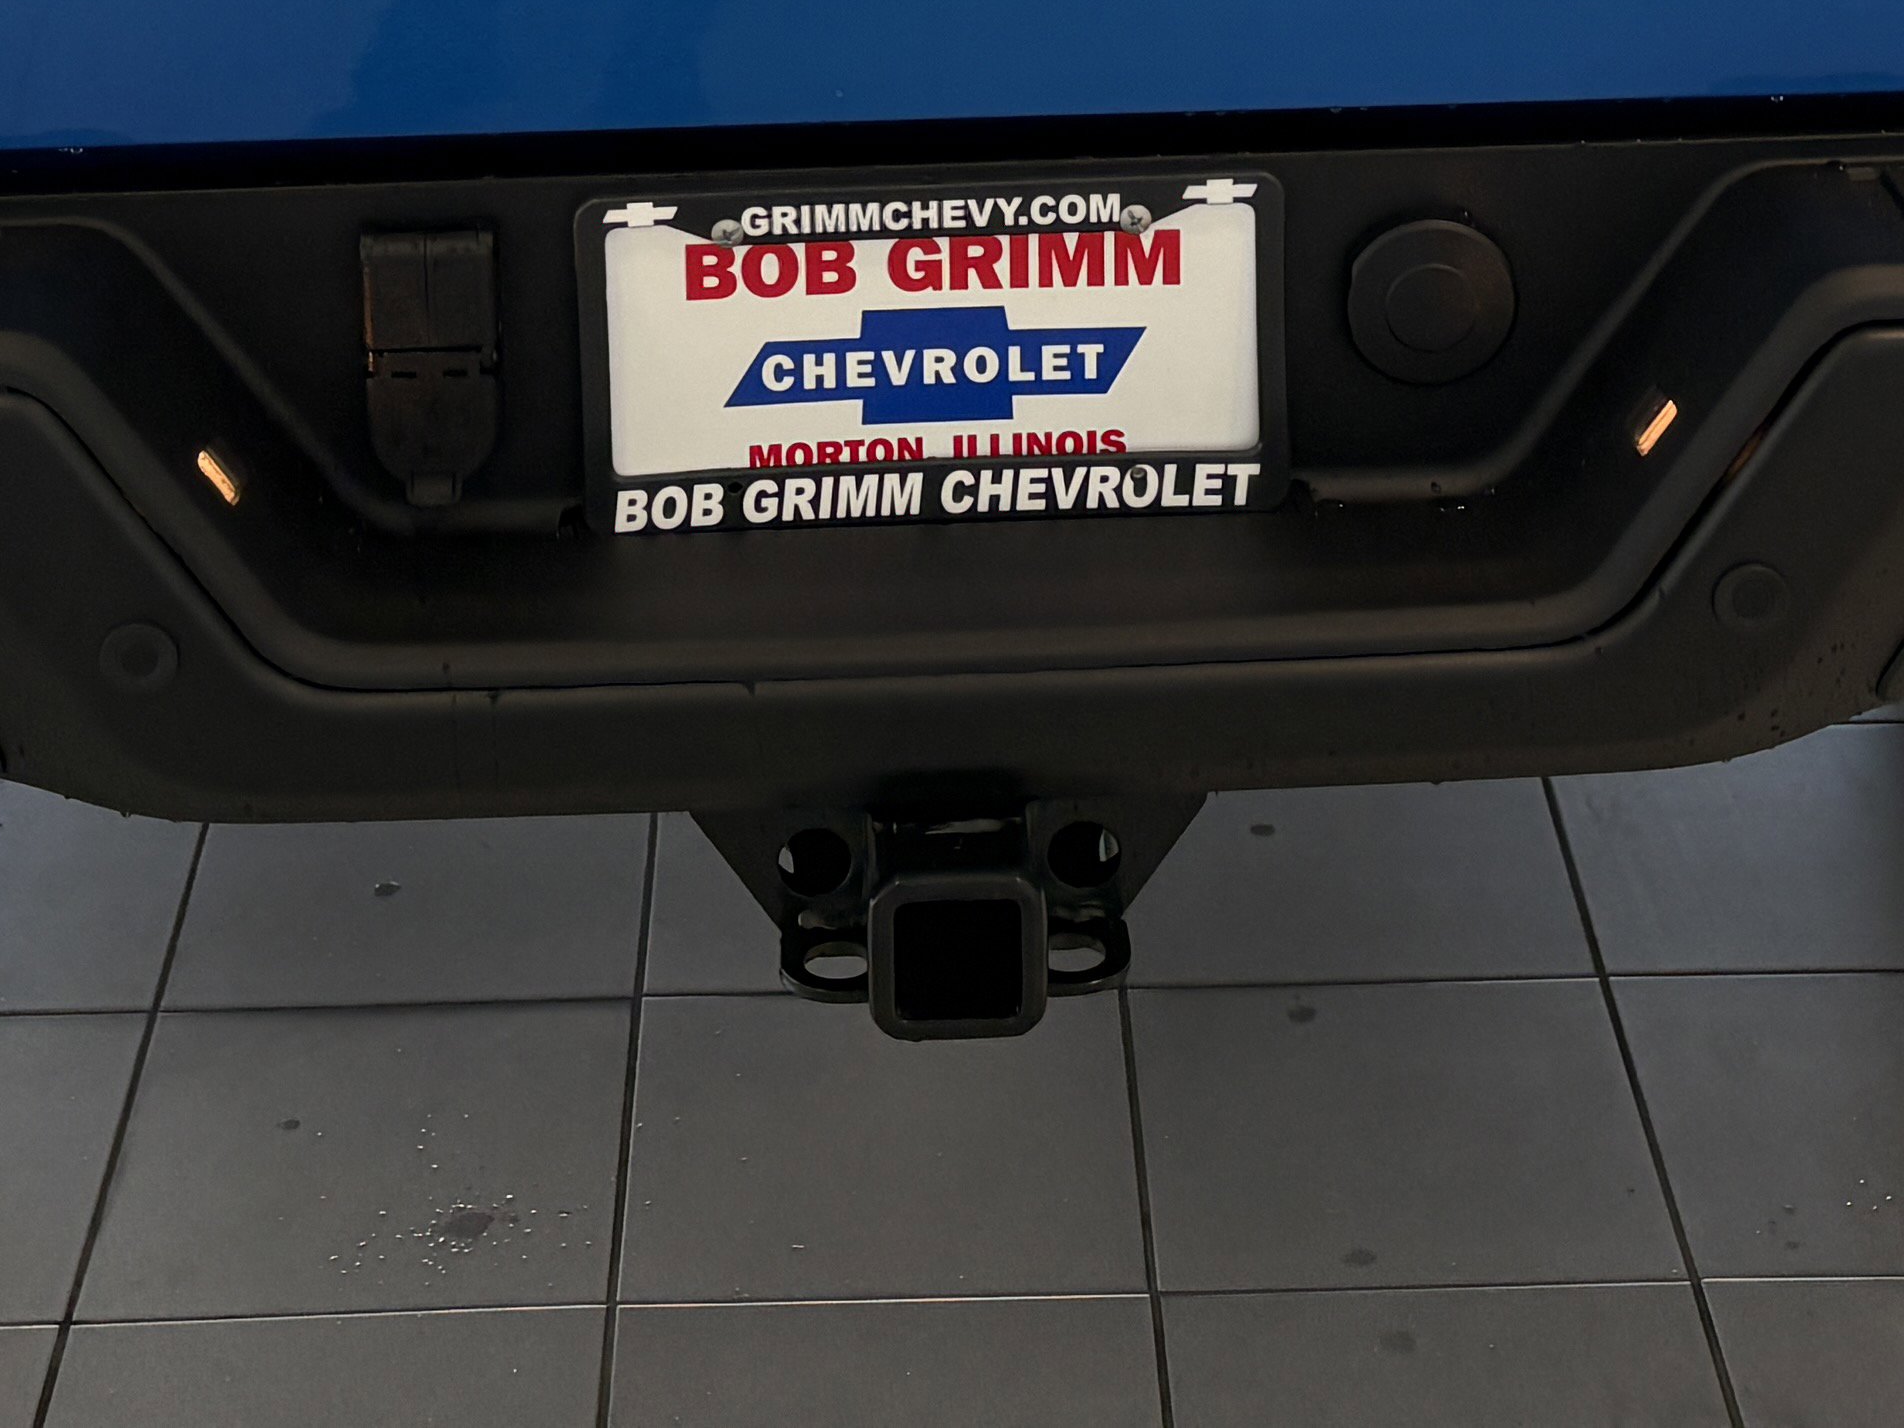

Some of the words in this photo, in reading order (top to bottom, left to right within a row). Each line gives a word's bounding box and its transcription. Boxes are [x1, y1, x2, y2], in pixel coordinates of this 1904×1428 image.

[741, 193, 1121, 237] GRIMMCHEVY.COM
[685, 240, 857, 301] BOB
[887, 229, 1181, 292] GRIMM
[761, 343, 1105, 392] CHEVROLET
[749, 436, 924, 470] MORTON
[614, 483, 725, 533] BOB
[742, 472, 924, 524] GRIMM
[940, 463, 1261, 514] CHEVROLET
